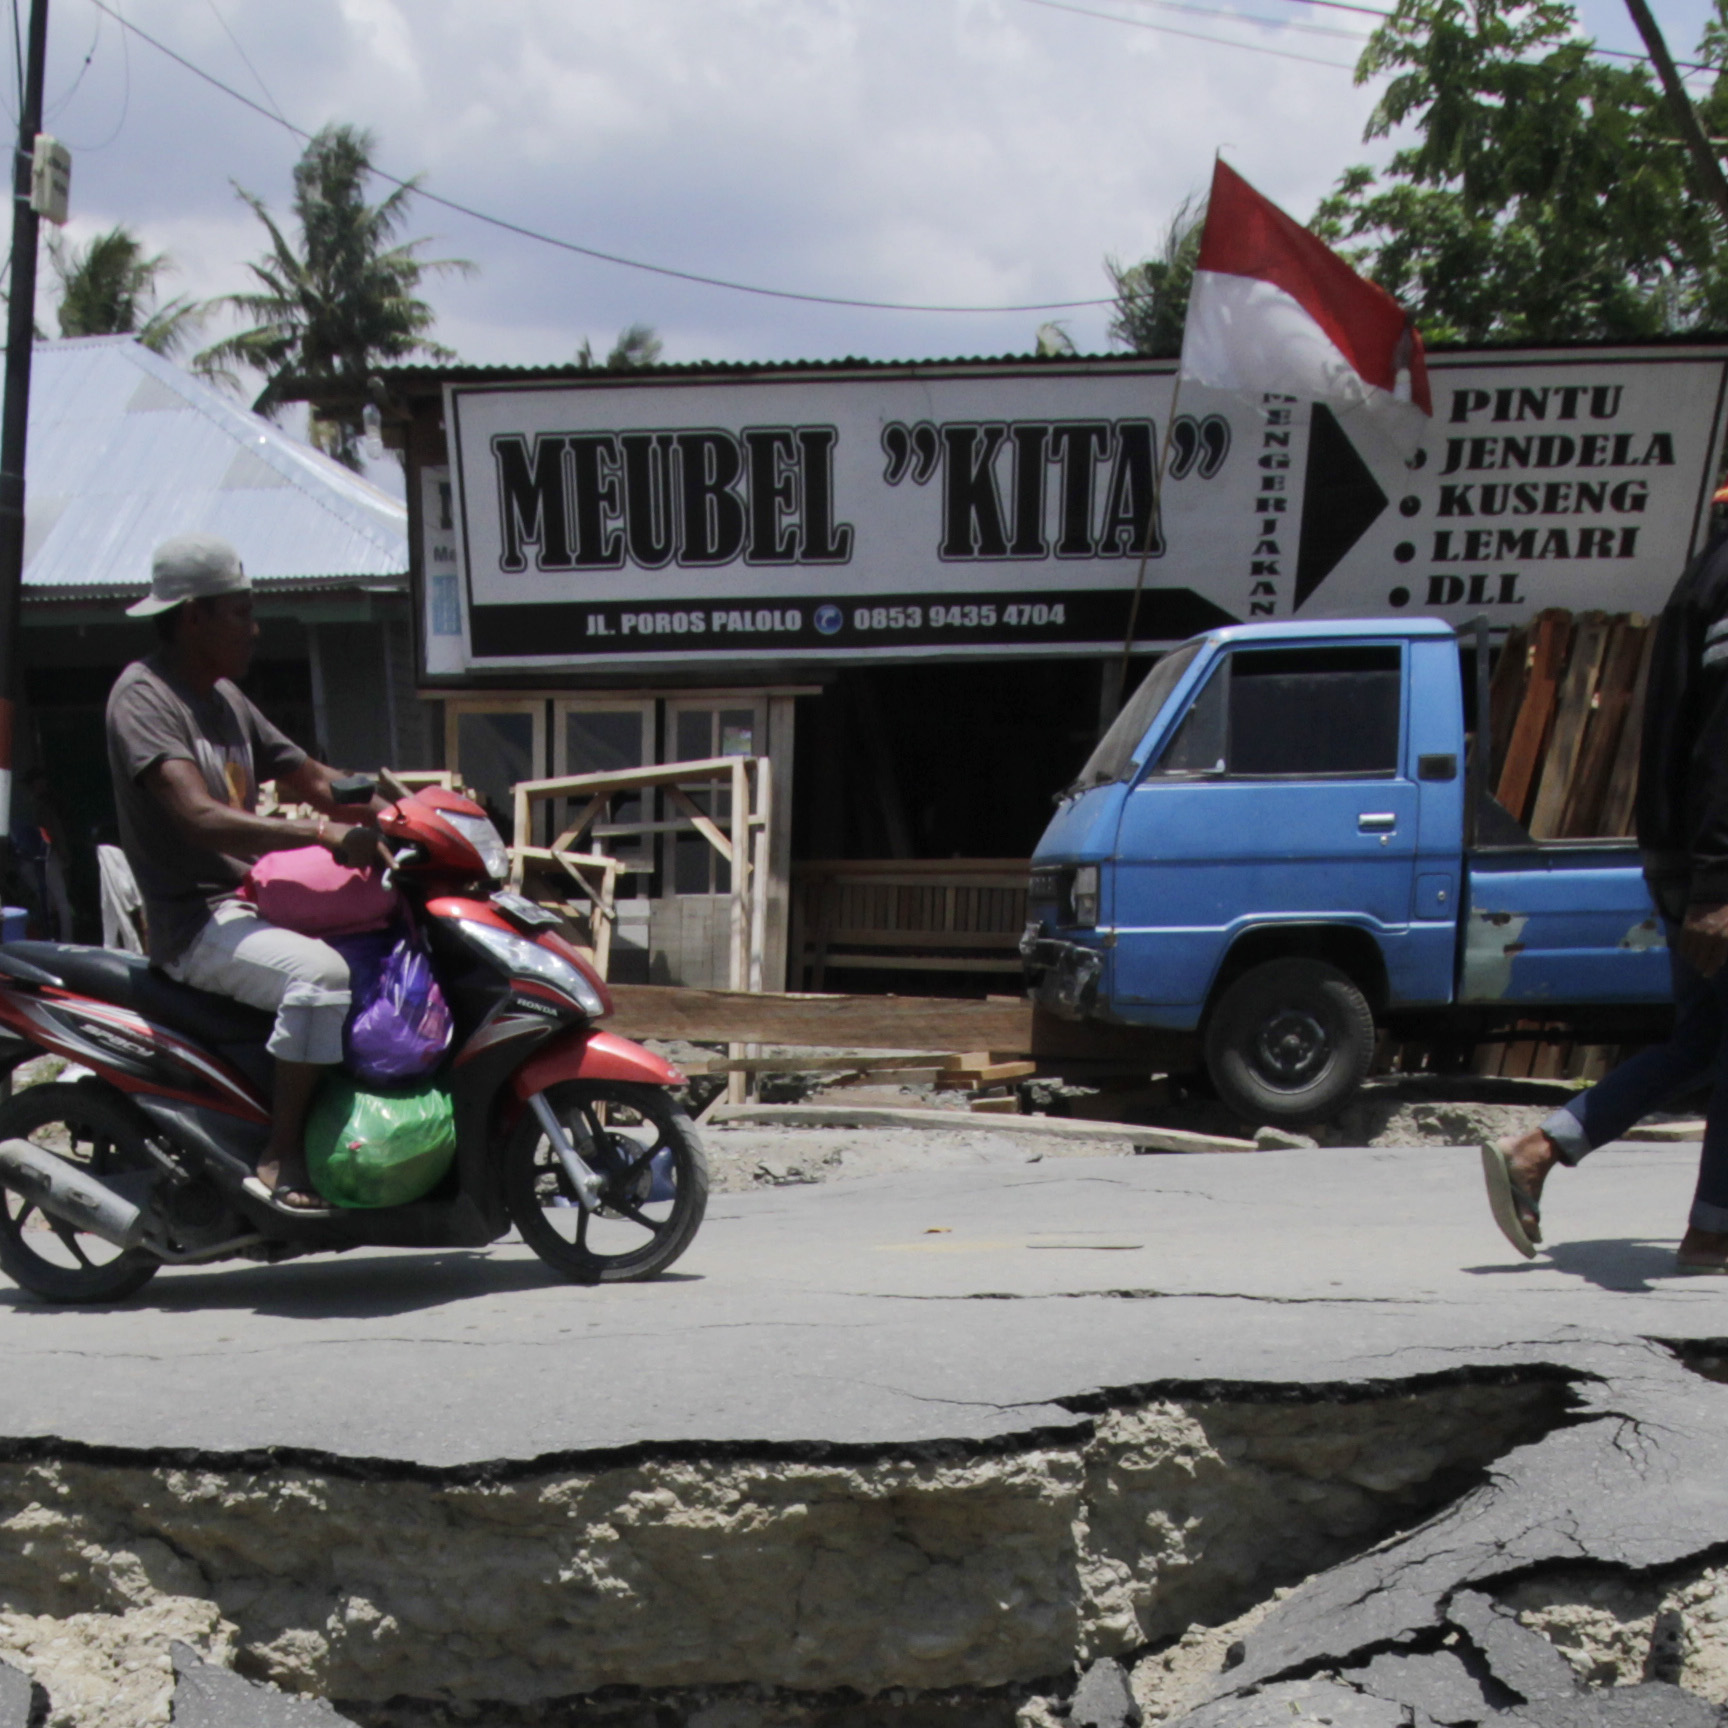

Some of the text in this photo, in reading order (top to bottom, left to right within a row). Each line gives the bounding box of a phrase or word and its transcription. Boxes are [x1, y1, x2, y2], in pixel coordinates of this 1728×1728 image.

[1448, 384, 1624, 423] PINTU
[1438, 432, 1676, 476] JENDELA
[490, 424, 855, 572] MEUBEL
[1435, 480, 1649, 517] KUSENG
[1430, 526, 1641, 562] LEMARI
[1424, 573, 1526, 606] DLL
[586, 603, 1066, 636] JL. POROS PALOLO 0853 9435 4704
[516, 997, 559, 1018] HONDA
